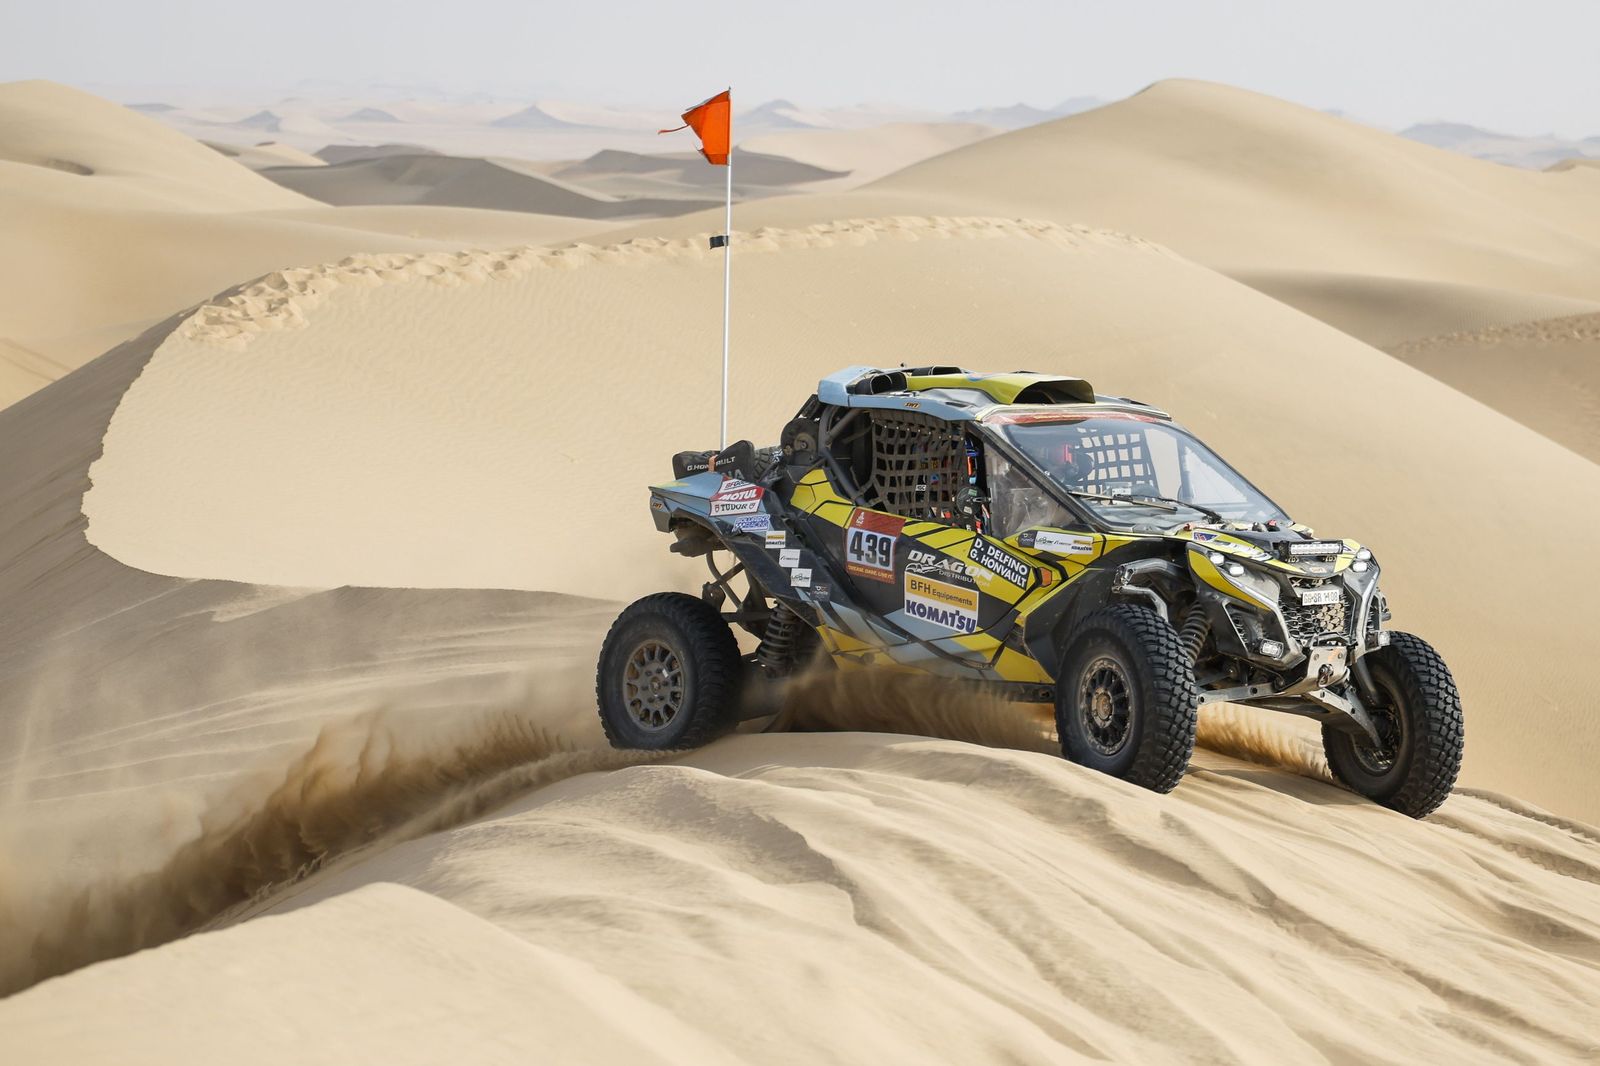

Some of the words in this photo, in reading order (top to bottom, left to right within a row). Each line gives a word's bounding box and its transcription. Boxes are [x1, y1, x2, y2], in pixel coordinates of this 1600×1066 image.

[719, 488, 757, 501] MOTUL
[720, 503, 748, 512] TUDOR
[849, 531, 892, 567] 439
[974, 538, 984, 551] D.
[987, 545, 1028, 576] DELFINO
[907, 550, 993, 582] DRAGON
[970, 549, 979, 561] G.
[981, 555, 1027, 589] HONVAULT
[911, 580, 931, 594] BFH
[932, 588, 973, 606] Equipements
[906, 599, 976, 633] KOMATSU
